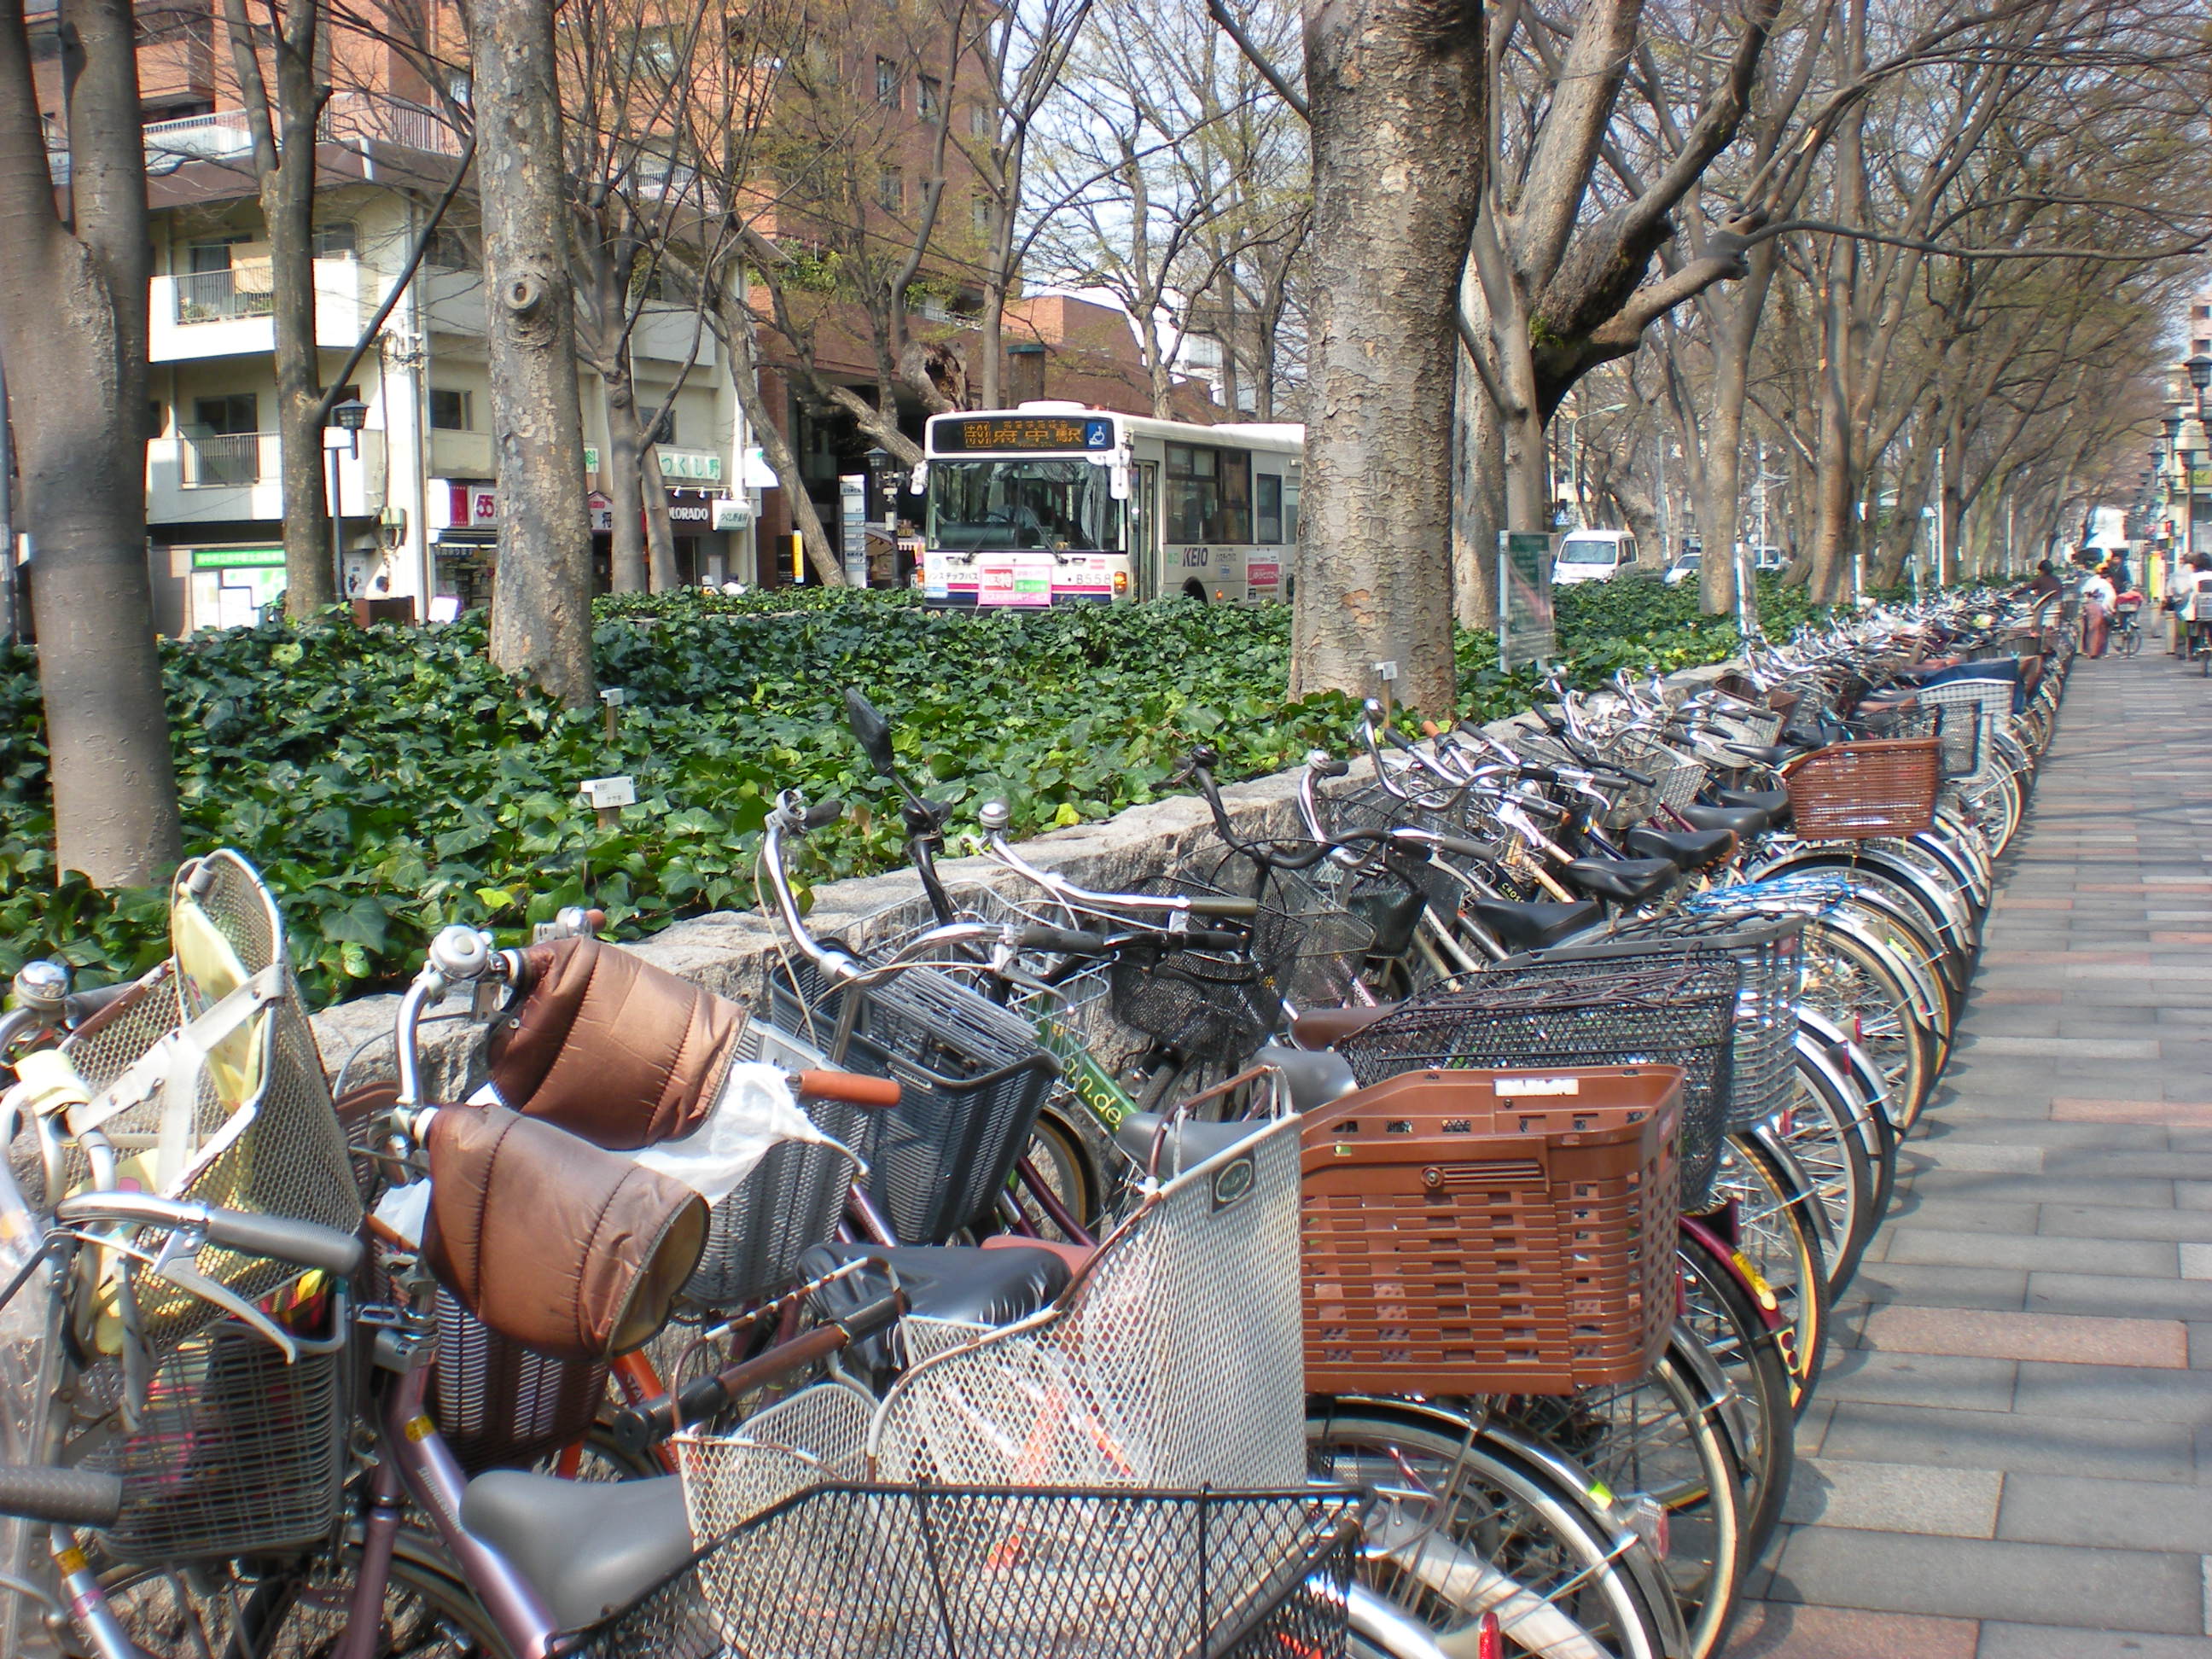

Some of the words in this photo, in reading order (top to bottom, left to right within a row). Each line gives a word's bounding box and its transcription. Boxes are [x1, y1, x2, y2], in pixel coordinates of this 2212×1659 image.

[993, 428, 1082, 445] 府中駅
[661, 457, 719, 478] つくし野
[1183, 548, 1208, 568] KEIO
